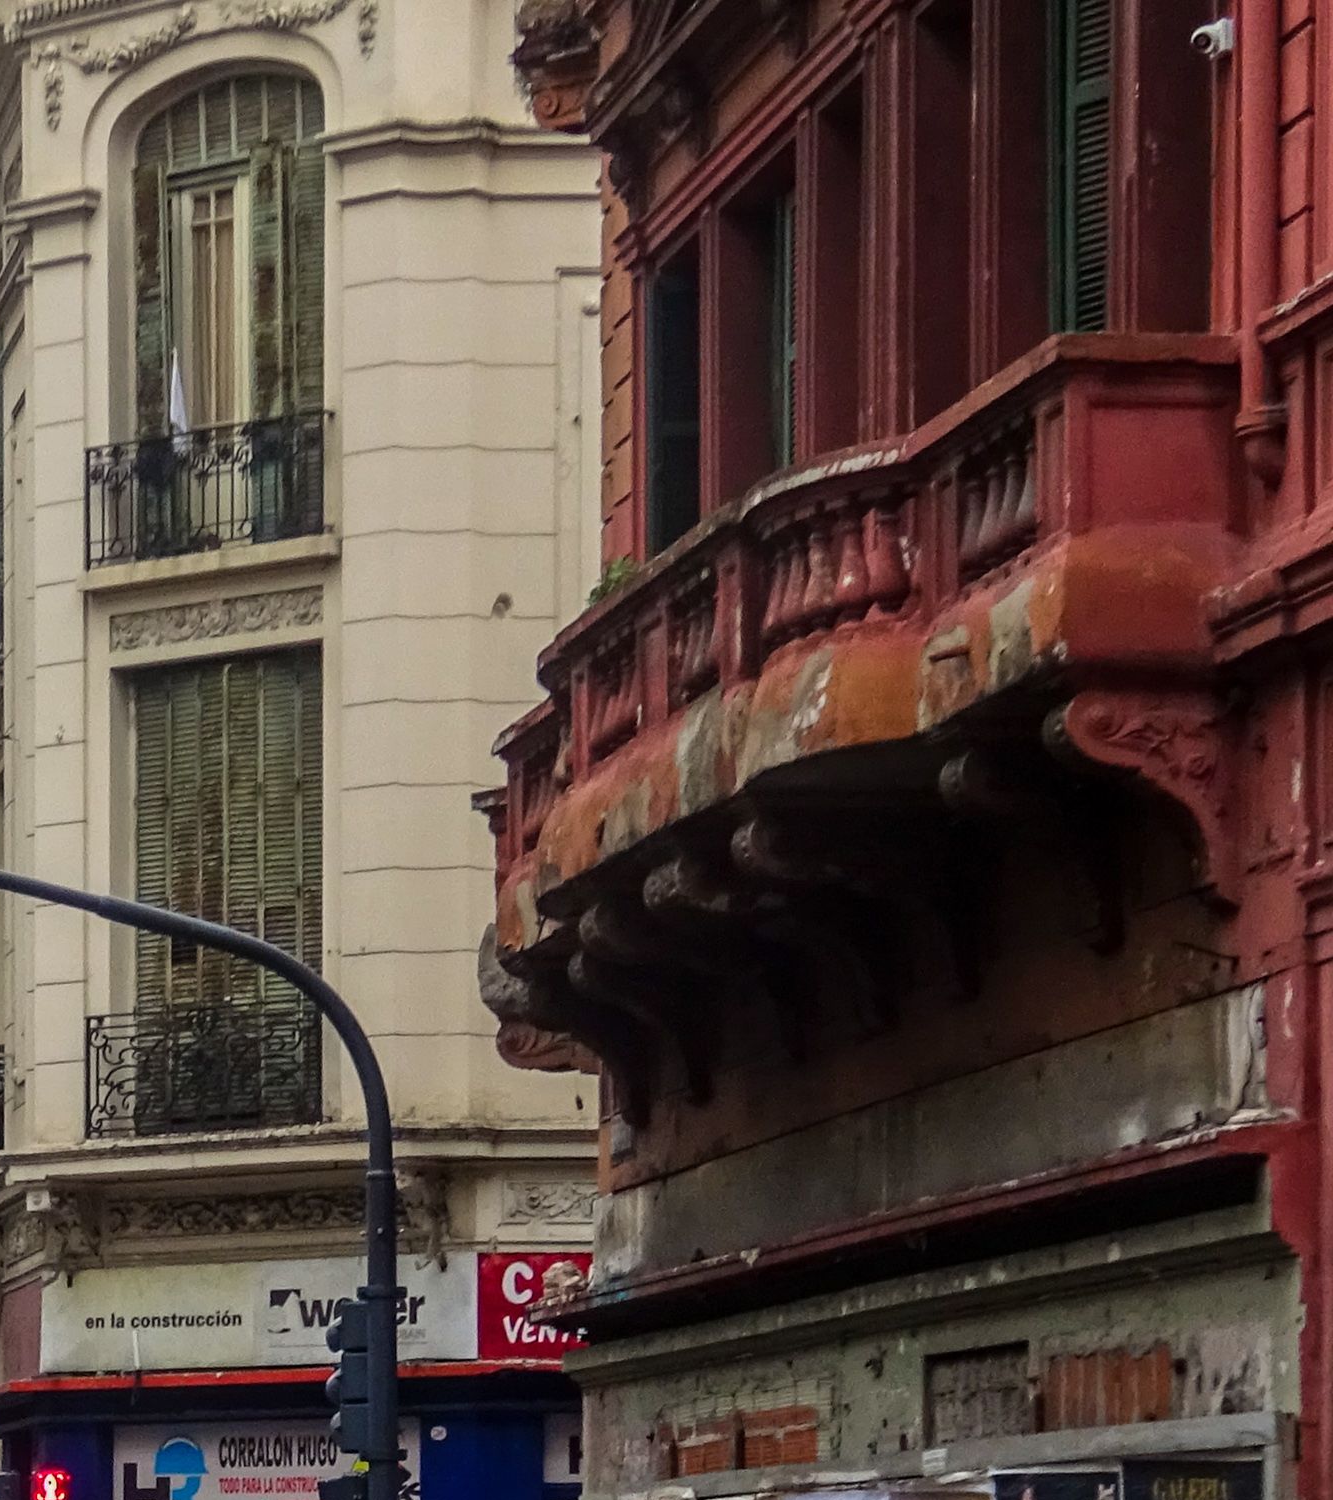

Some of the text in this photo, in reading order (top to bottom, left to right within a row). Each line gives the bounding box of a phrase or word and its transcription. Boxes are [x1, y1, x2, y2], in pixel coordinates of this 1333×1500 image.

[85, 1309, 242, 1329] en la construcción
[298, 1434, 338, 1467] HUGO
